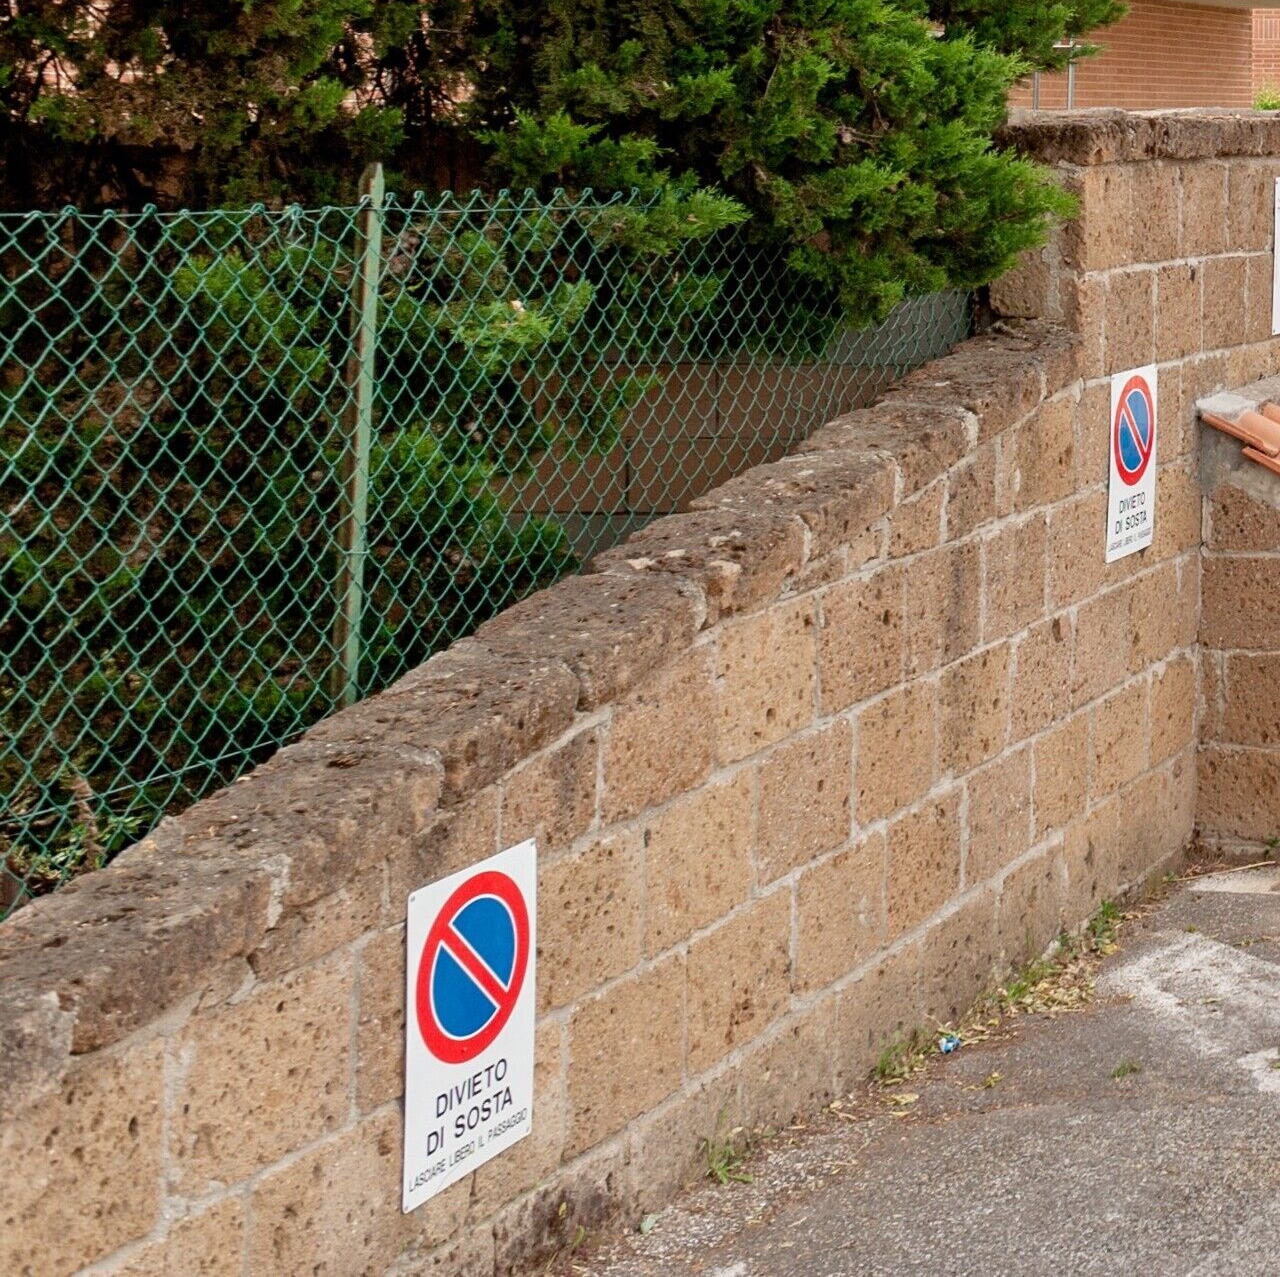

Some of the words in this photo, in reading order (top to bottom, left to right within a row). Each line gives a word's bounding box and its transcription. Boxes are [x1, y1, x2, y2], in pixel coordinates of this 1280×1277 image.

[1115, 519, 1123, 535] DI
[1125, 510, 1147, 531] SOSTA
[1119, 491, 1145, 514] DIVIETO
[436, 1058, 508, 1119] DIVIETO
[408, 1158, 446, 1193] LASCIARE
[449, 1140, 476, 1168] LIBERO
[478, 1134, 485, 1148] IL
[487, 1107, 528, 1141] PASSAGGIO
[426, 1125, 445, 1157] DI
[454, 1085, 514, 1139] SOSTA
